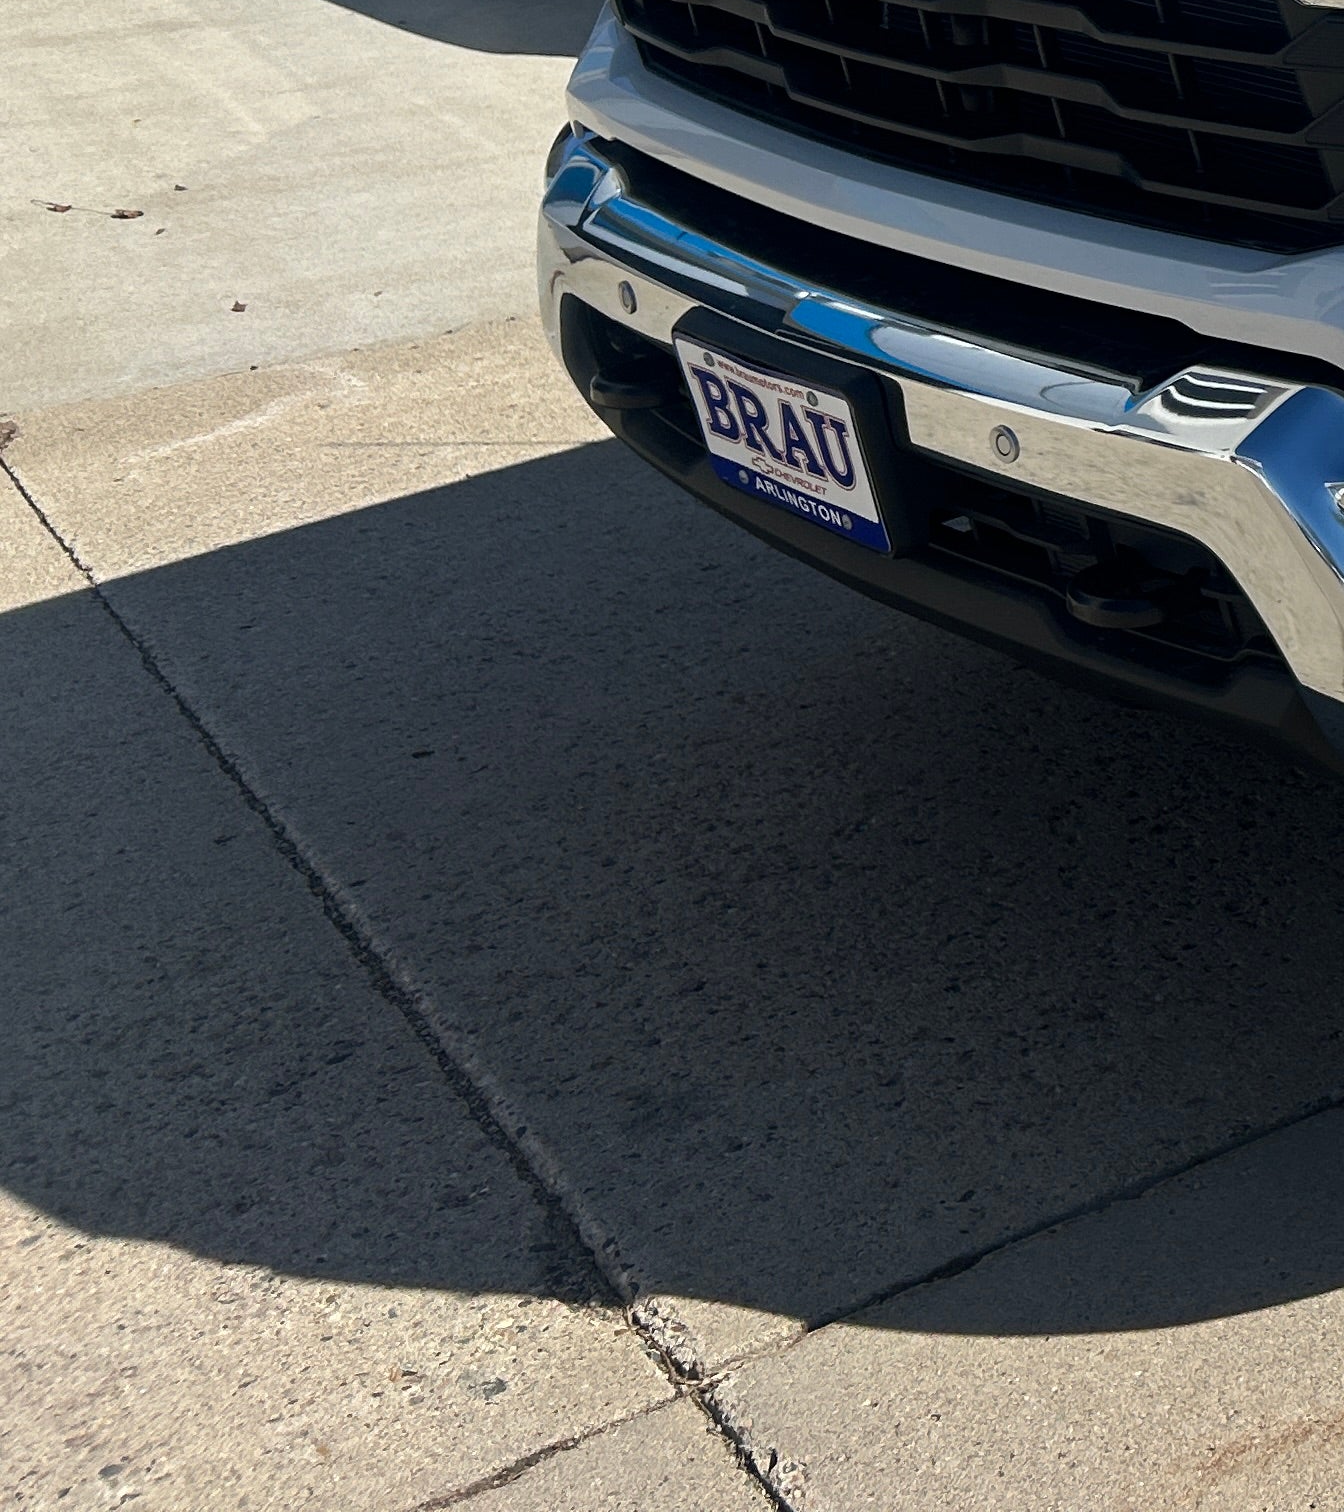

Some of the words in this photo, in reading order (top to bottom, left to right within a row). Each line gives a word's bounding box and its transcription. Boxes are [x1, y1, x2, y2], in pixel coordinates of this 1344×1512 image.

[687, 361, 857, 491] BRAU
[755, 475, 843, 528] ARLINGTON
[774, 467, 828, 496] CHEVROLET
